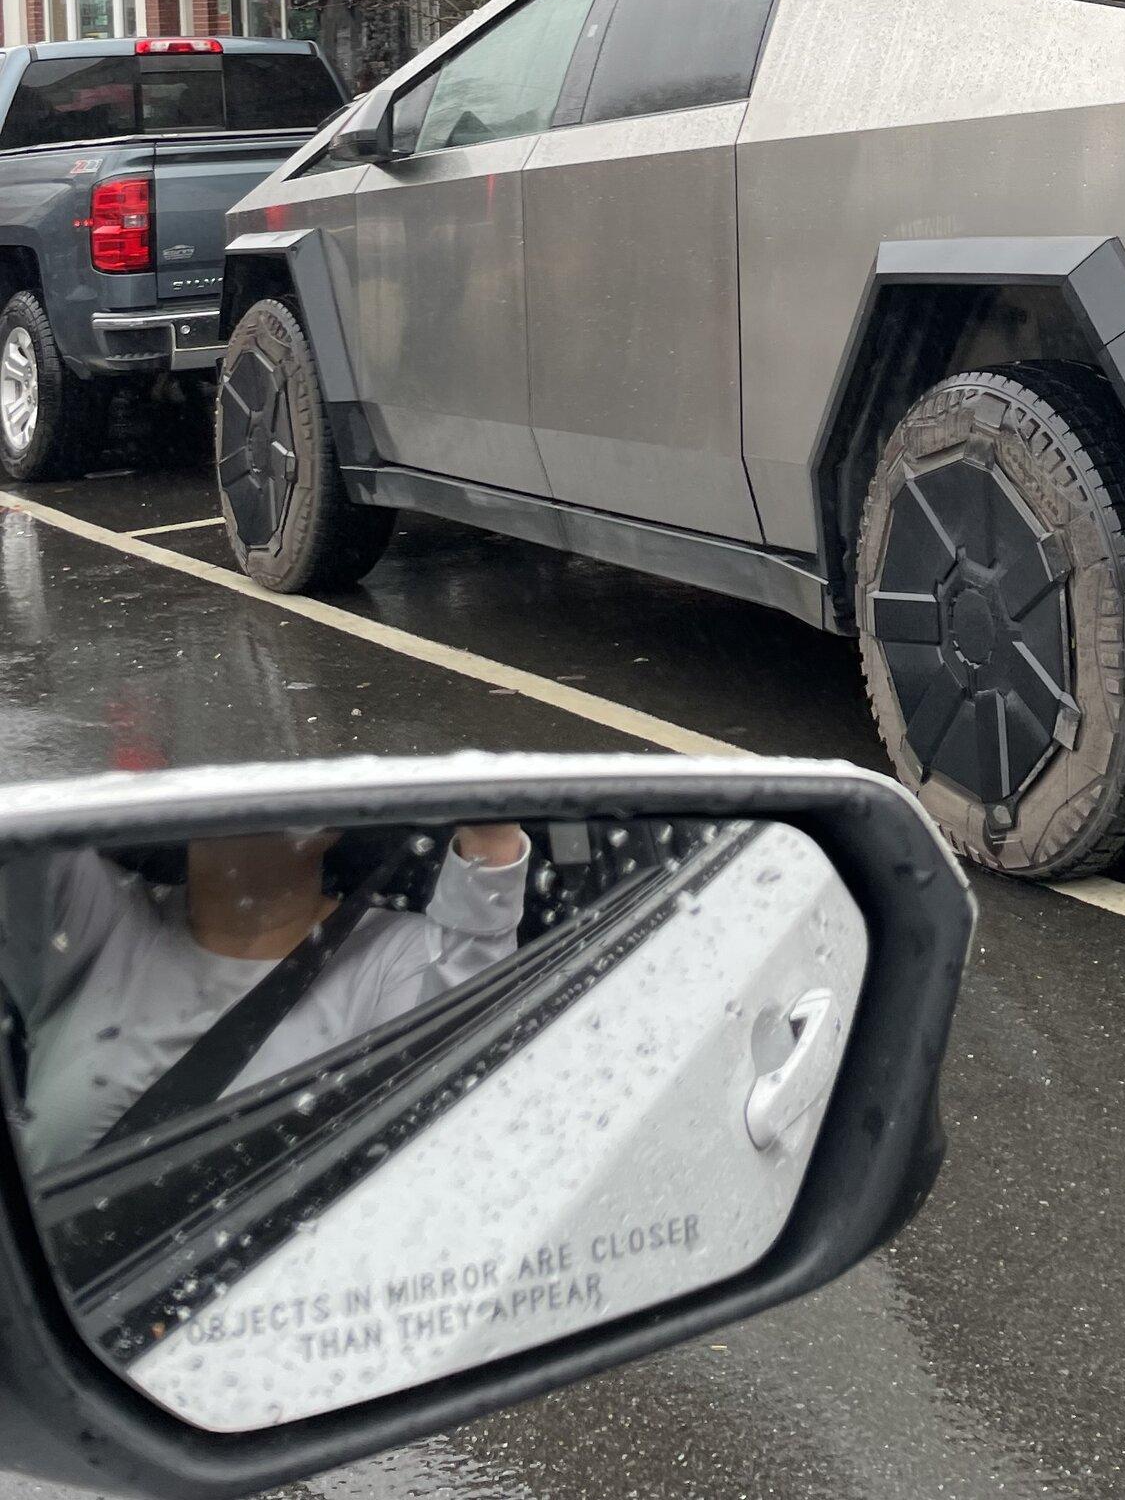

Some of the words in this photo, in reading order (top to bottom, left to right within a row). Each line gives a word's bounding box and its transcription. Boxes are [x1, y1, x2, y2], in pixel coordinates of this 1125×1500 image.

[187, 1293, 331, 1346] OBJECTS
[345, 1284, 373, 1316] IN
[386, 1258, 500, 1310] MIRROR
[518, 1243, 573, 1279] ARE
[591, 1214, 701, 1264] CLOSER
[300, 1318, 382, 1363] THAN
[398, 1296, 473, 1342] THEY
[490, 1271, 603, 1323] APPEAR
